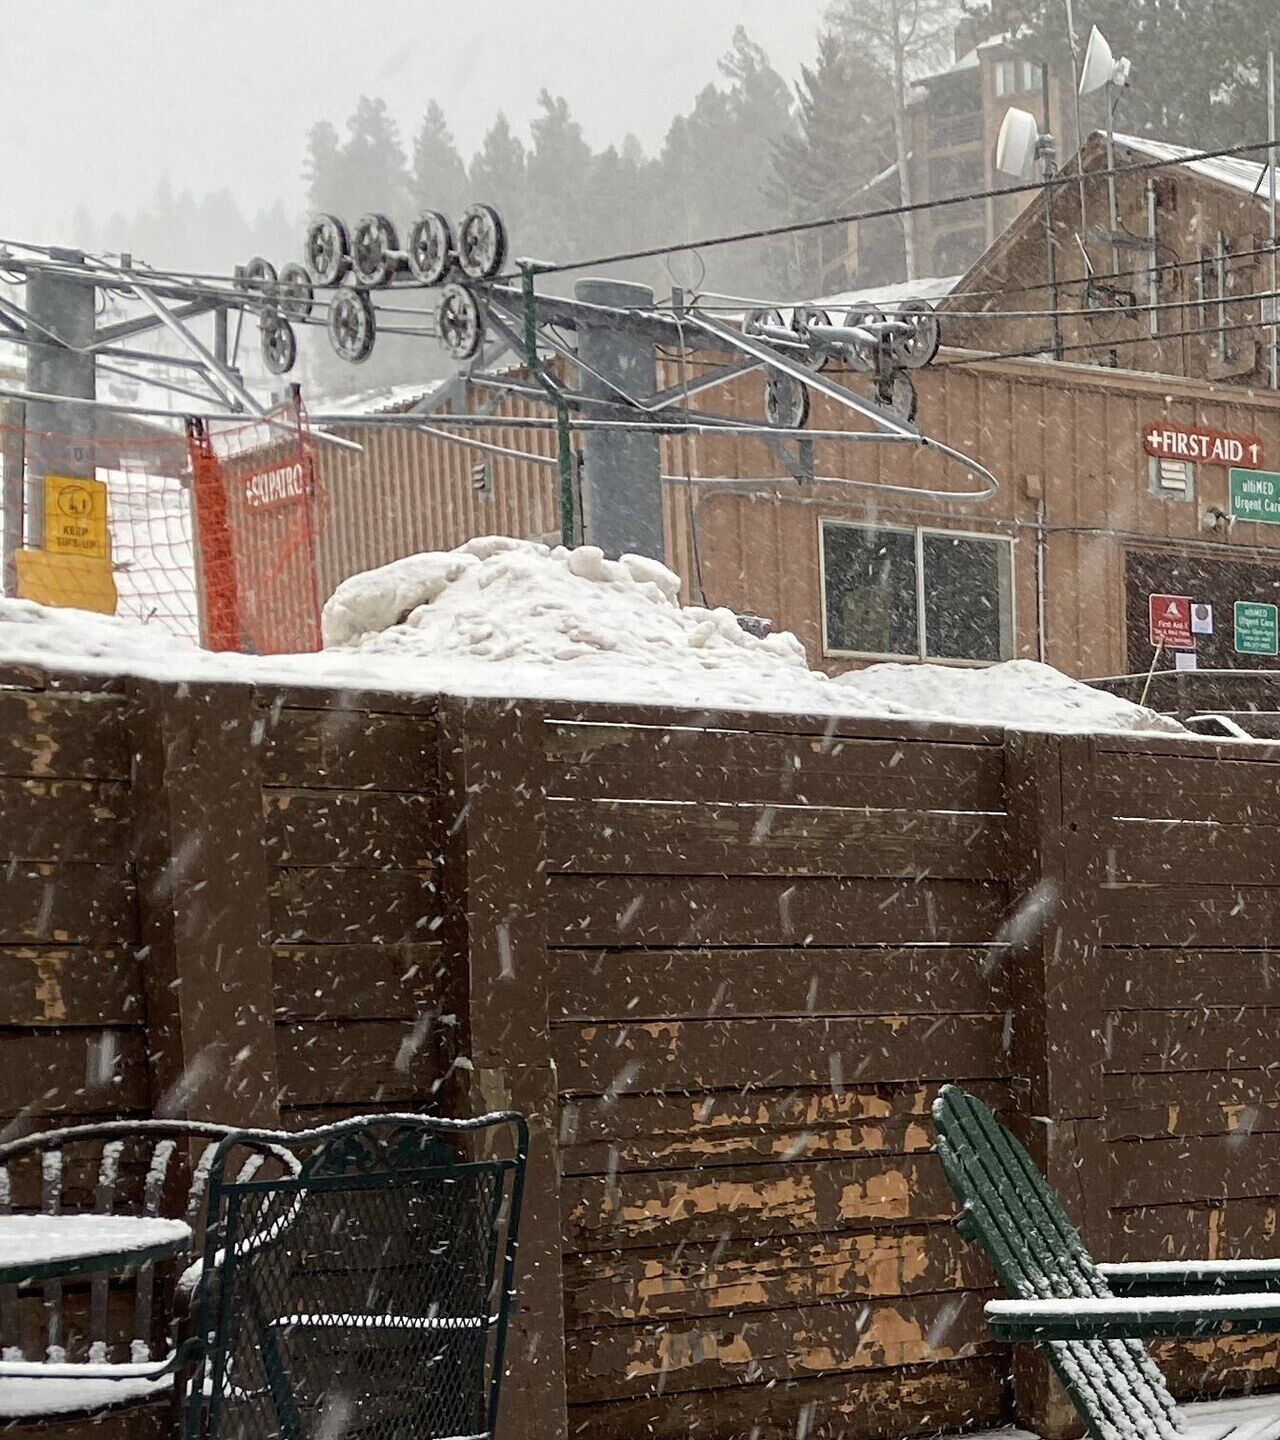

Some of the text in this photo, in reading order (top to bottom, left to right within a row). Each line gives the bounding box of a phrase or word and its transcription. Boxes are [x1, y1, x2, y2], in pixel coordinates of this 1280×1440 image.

[1162, 430, 1210, 457] FIRST
[1211, 437, 1243, 462] AID
[1234, 496, 1262, 513] Urgent
